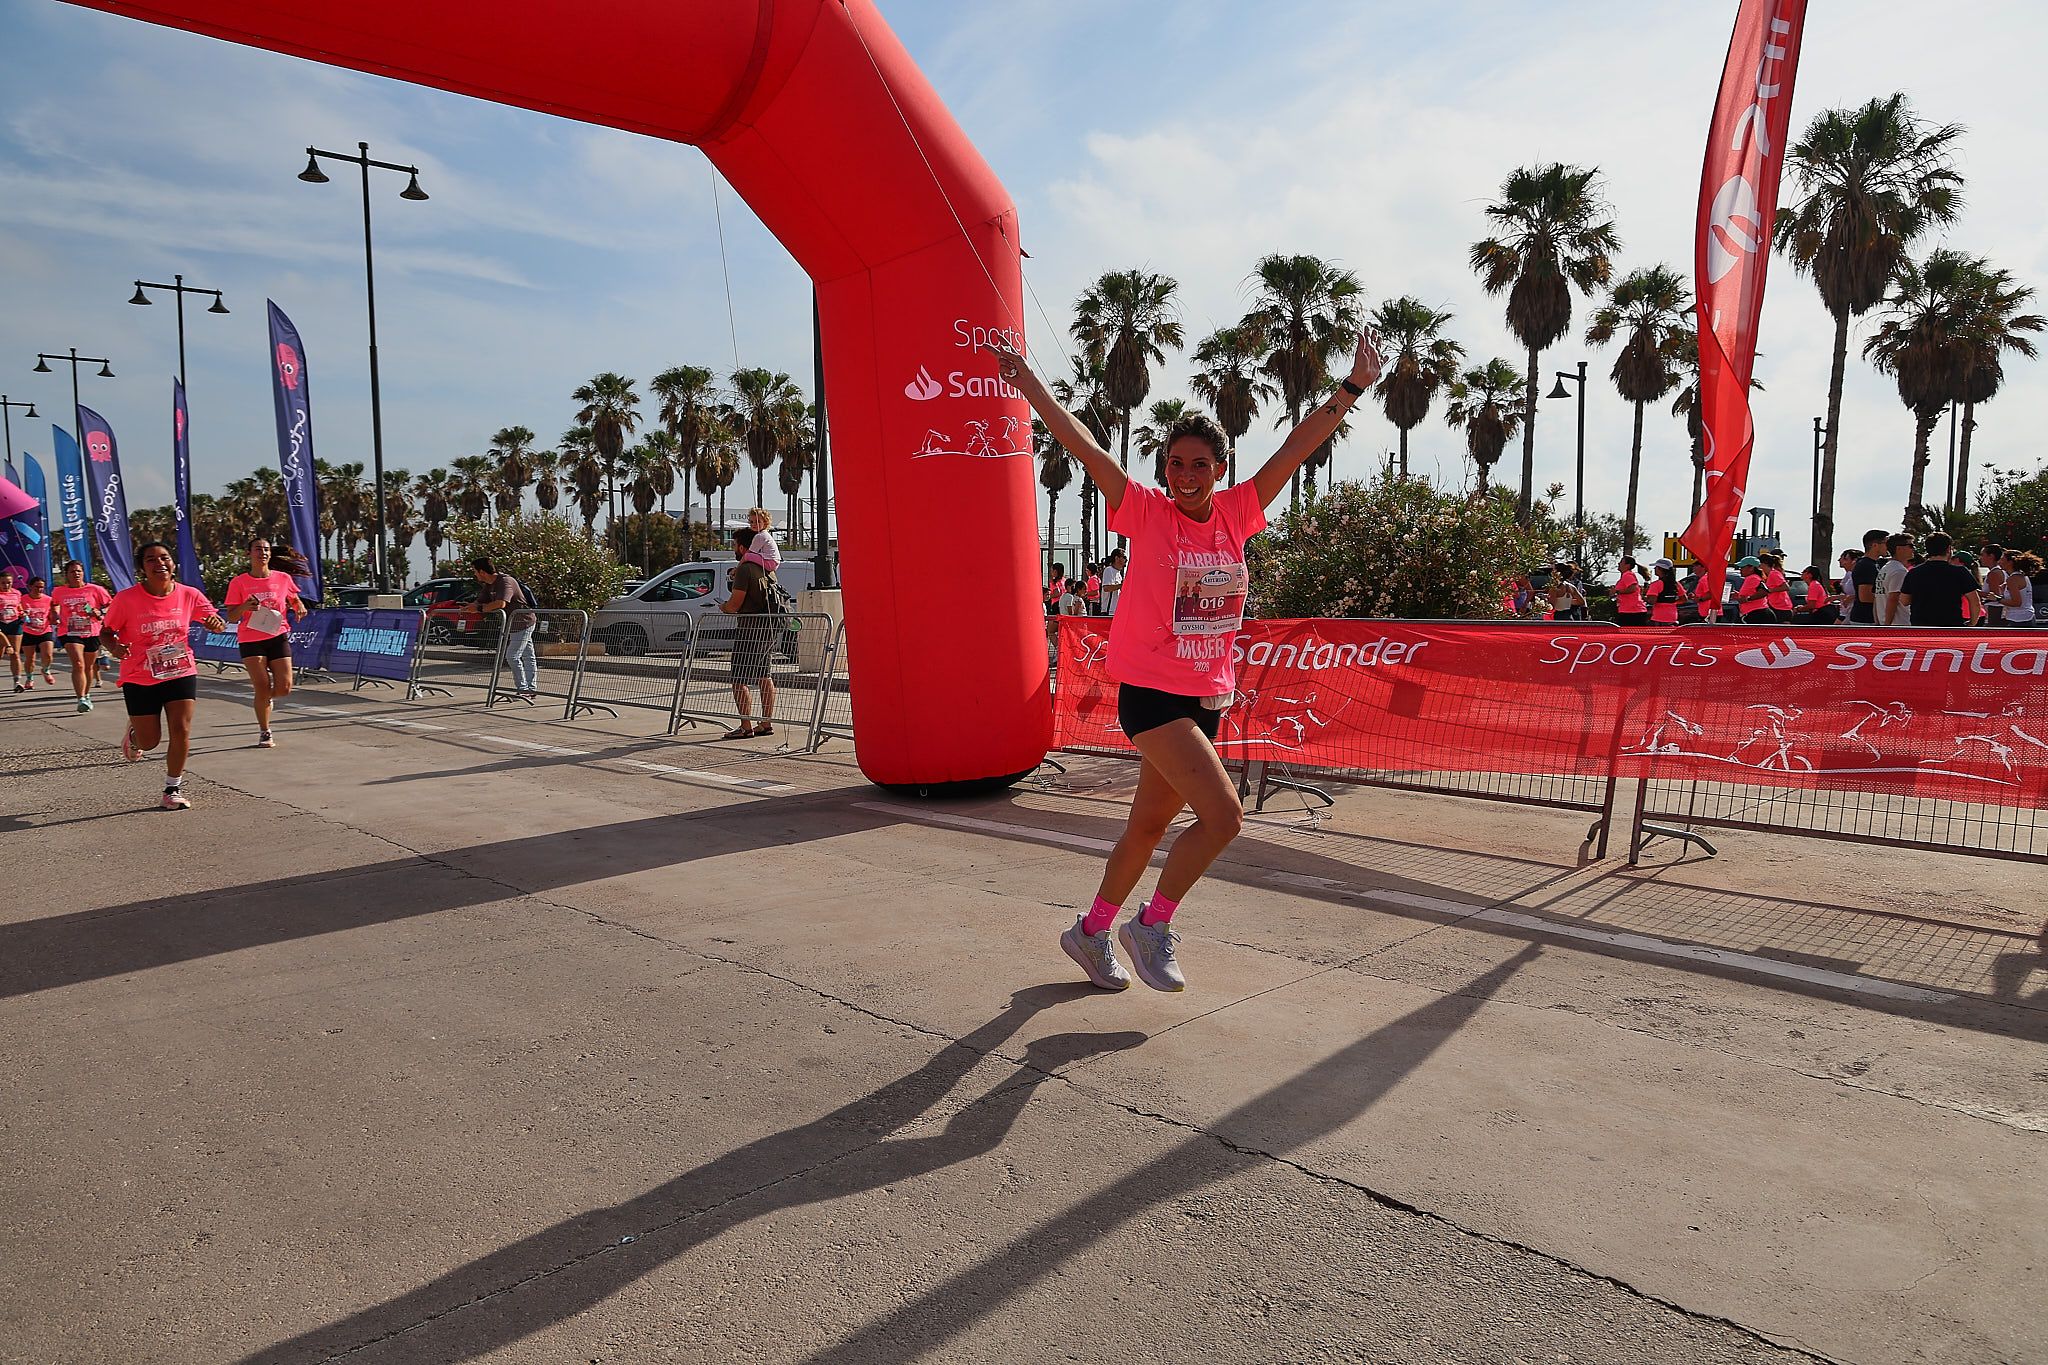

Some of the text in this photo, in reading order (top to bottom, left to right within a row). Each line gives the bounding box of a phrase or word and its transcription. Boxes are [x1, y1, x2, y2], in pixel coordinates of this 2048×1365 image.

[954, 319, 1022, 354] Sports
[1199, 596, 1225, 609] 016
[140, 619, 182, 634] CARRERA
[1176, 636, 1226, 659] MUJER
[1231, 634, 1429, 671] Santander
[1539, 636, 2048, 676] Sports Santa
